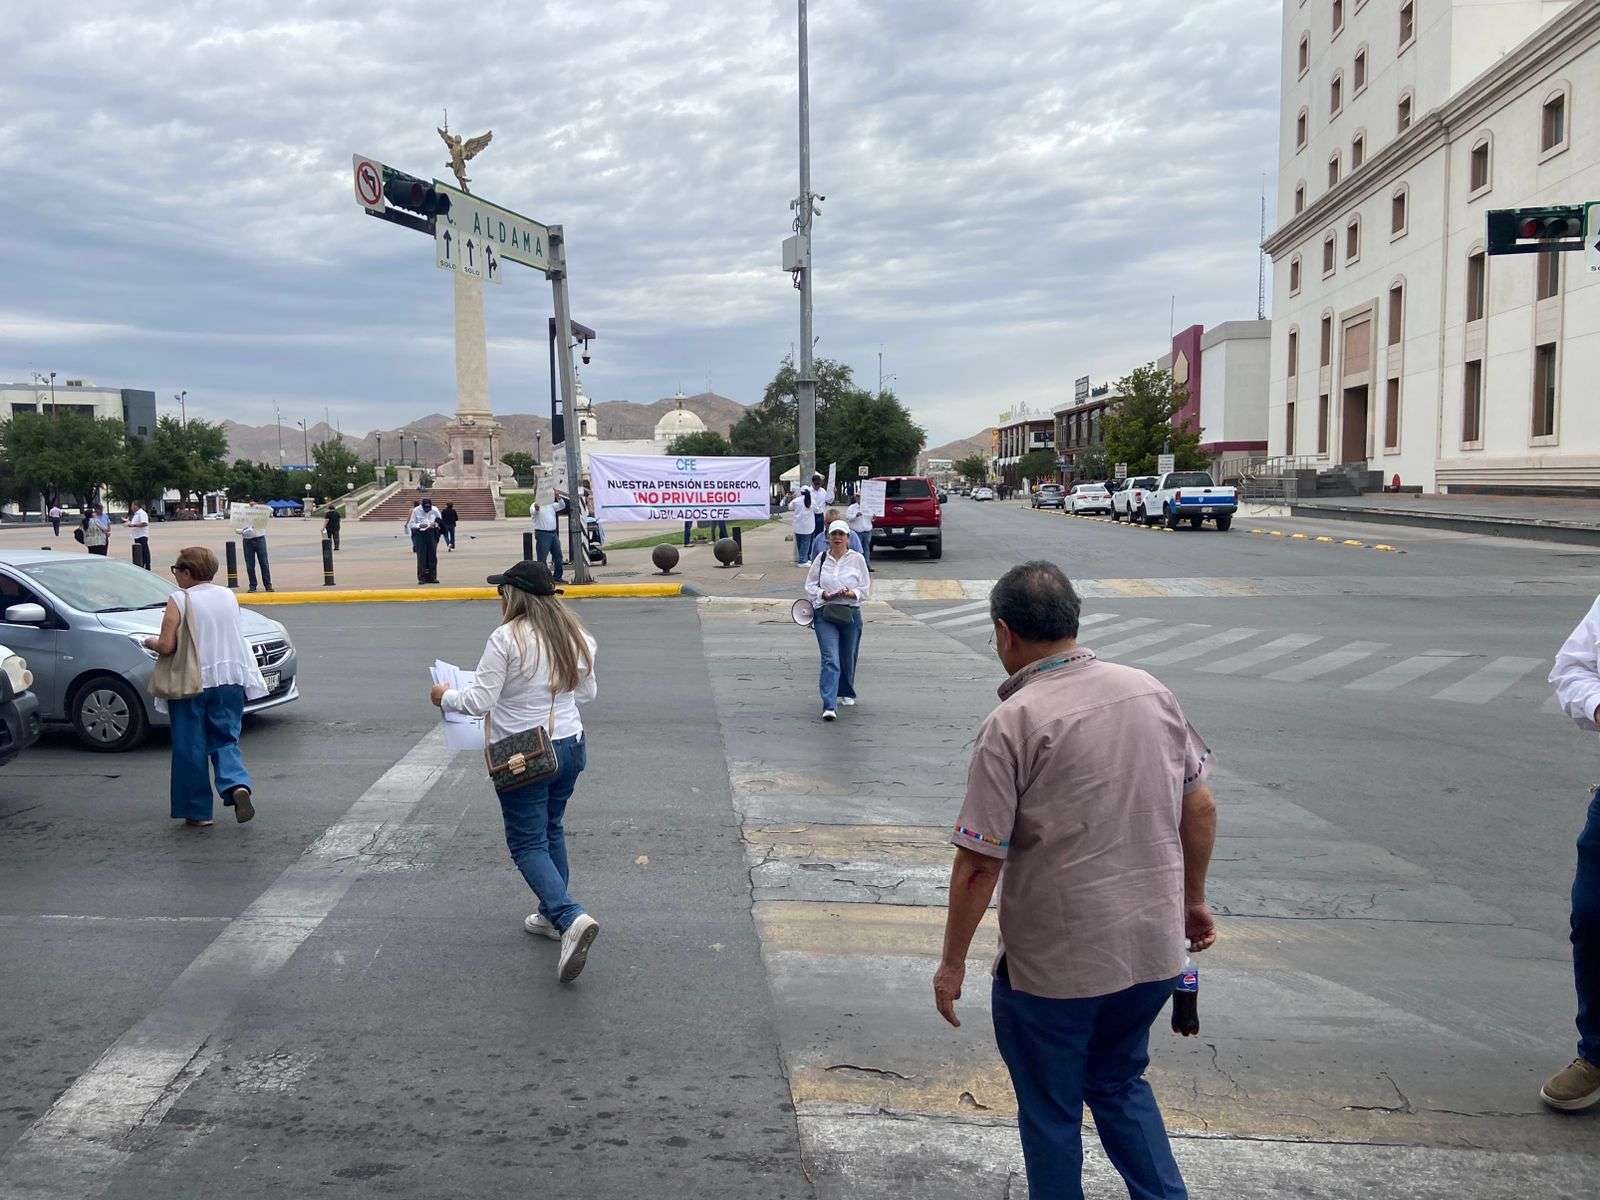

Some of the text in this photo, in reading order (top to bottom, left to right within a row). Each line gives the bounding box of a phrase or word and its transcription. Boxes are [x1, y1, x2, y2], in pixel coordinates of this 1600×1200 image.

[474, 212, 543, 257] ALDAMA
[440, 259, 456, 270] SOLO
[464, 266, 481, 276] SOLO
[676, 458, 696, 471] CFE
[607, 478, 761, 490] NUESTRA PENSIÓN ES DERECHO,
[633, 491, 741, 504] ¡NO PRIVILEGIO!
[648, 508, 730, 520] JUBILADOS CFE
